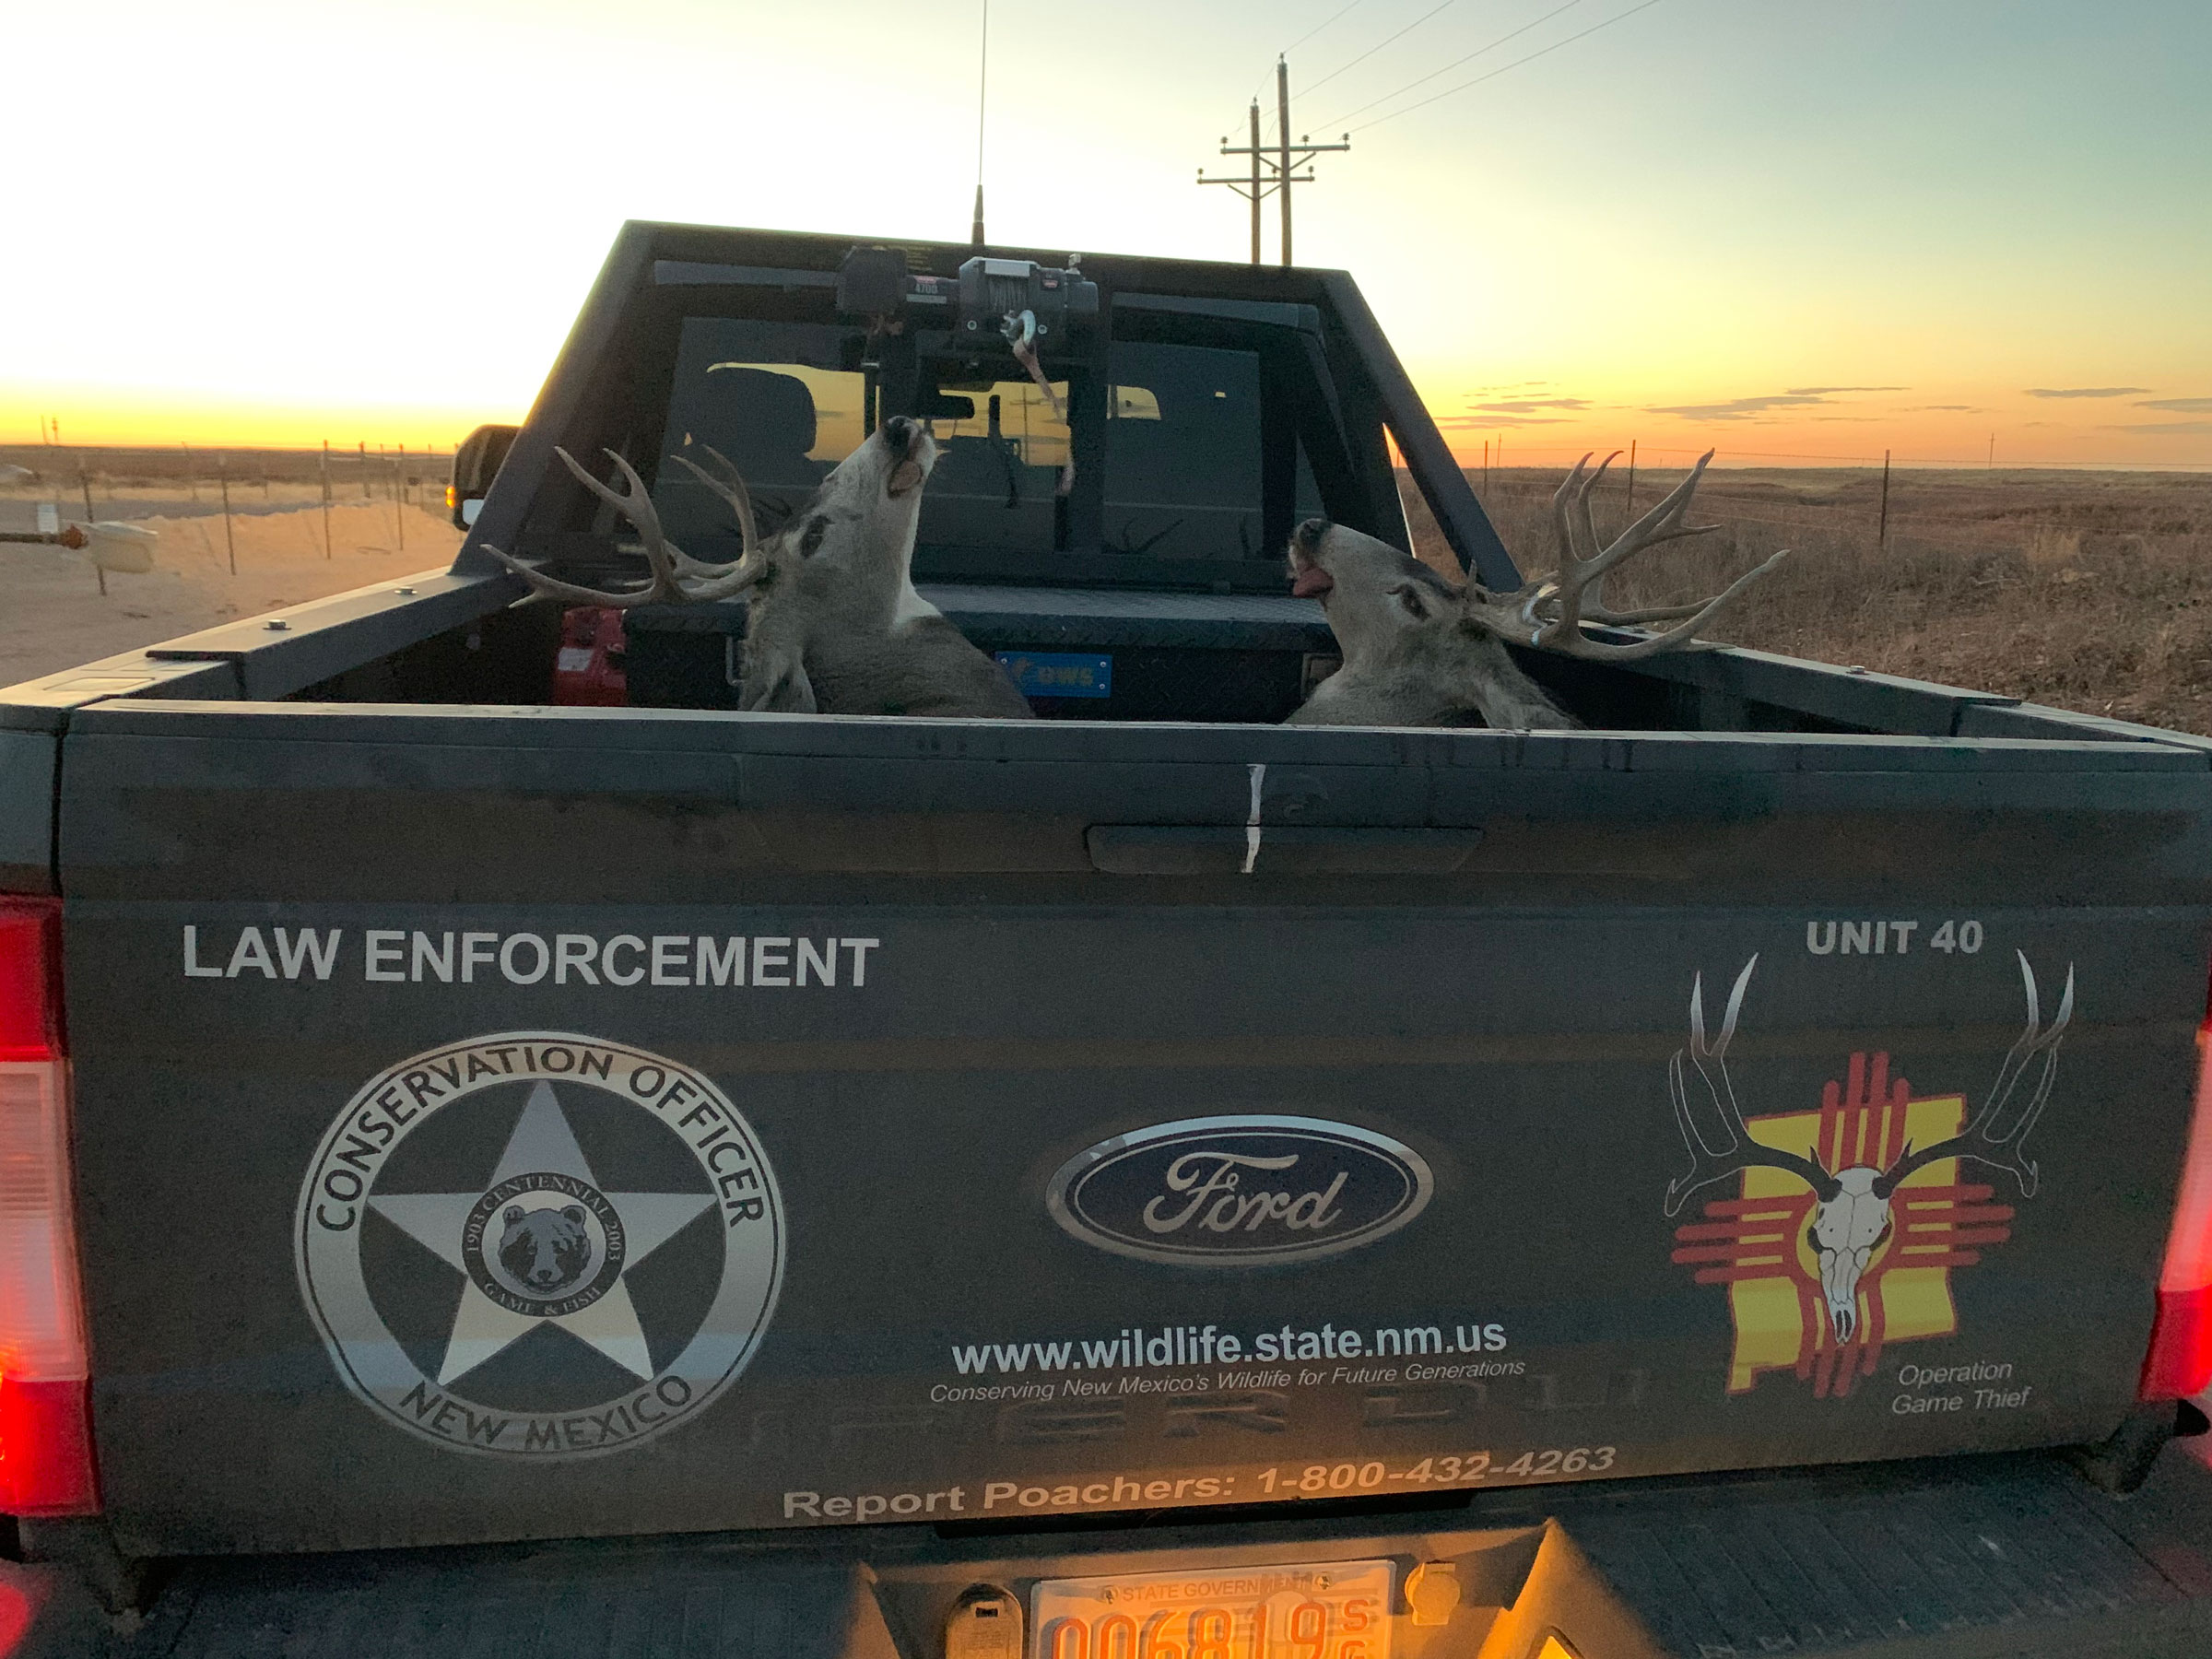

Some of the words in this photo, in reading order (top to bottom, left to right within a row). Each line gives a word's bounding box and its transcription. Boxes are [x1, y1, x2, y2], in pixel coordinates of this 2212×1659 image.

[184, 925, 341, 979] LAW
[366, 929, 880, 987] ENFORCEMENT
[1806, 920, 1918, 955] UNIT
[1931, 920, 1983, 954] 40
[316, 1047, 614, 1232] CONSERVATION
[629, 1065, 764, 1228] OFFICER
[1143, 1151, 1348, 1233] Ford
[466, 1213, 485, 1252] 1903
[482, 1175, 608, 1218] CENTENNIAL
[605, 1221, 621, 1261] 2003
[485, 1282, 535, 1313] GAME
[563, 1286, 601, 1312] FISH
[952, 1324, 1507, 1374] www.wildlife.state.nm.us
[930, 1381, 1054, 1402] Conserving
[1062, 1379, 1112, 1397] New
[1118, 1373, 1209, 1394] Mexico's
[1218, 1369, 1290, 1390] Wildlife
[1298, 1368, 1326, 1384] for
[1332, 1366, 1397, 1384] Future
[1405, 1359, 1526, 1381] Generations
[1899, 1360, 2012, 1389] Operation
[400, 1379, 510, 1445] NEW
[524, 1373, 692, 1451] MEXICO
[1892, 1394, 1963, 1415] Game
[1974, 1385, 2032, 1410] Thief
[783, 1485, 965, 1522] Report
[983, 1477, 1233, 1510] Poachers:
[1257, 1446, 1617, 1494] 1-800-432-4263
[1123, 1583, 1181, 1602] STATE
